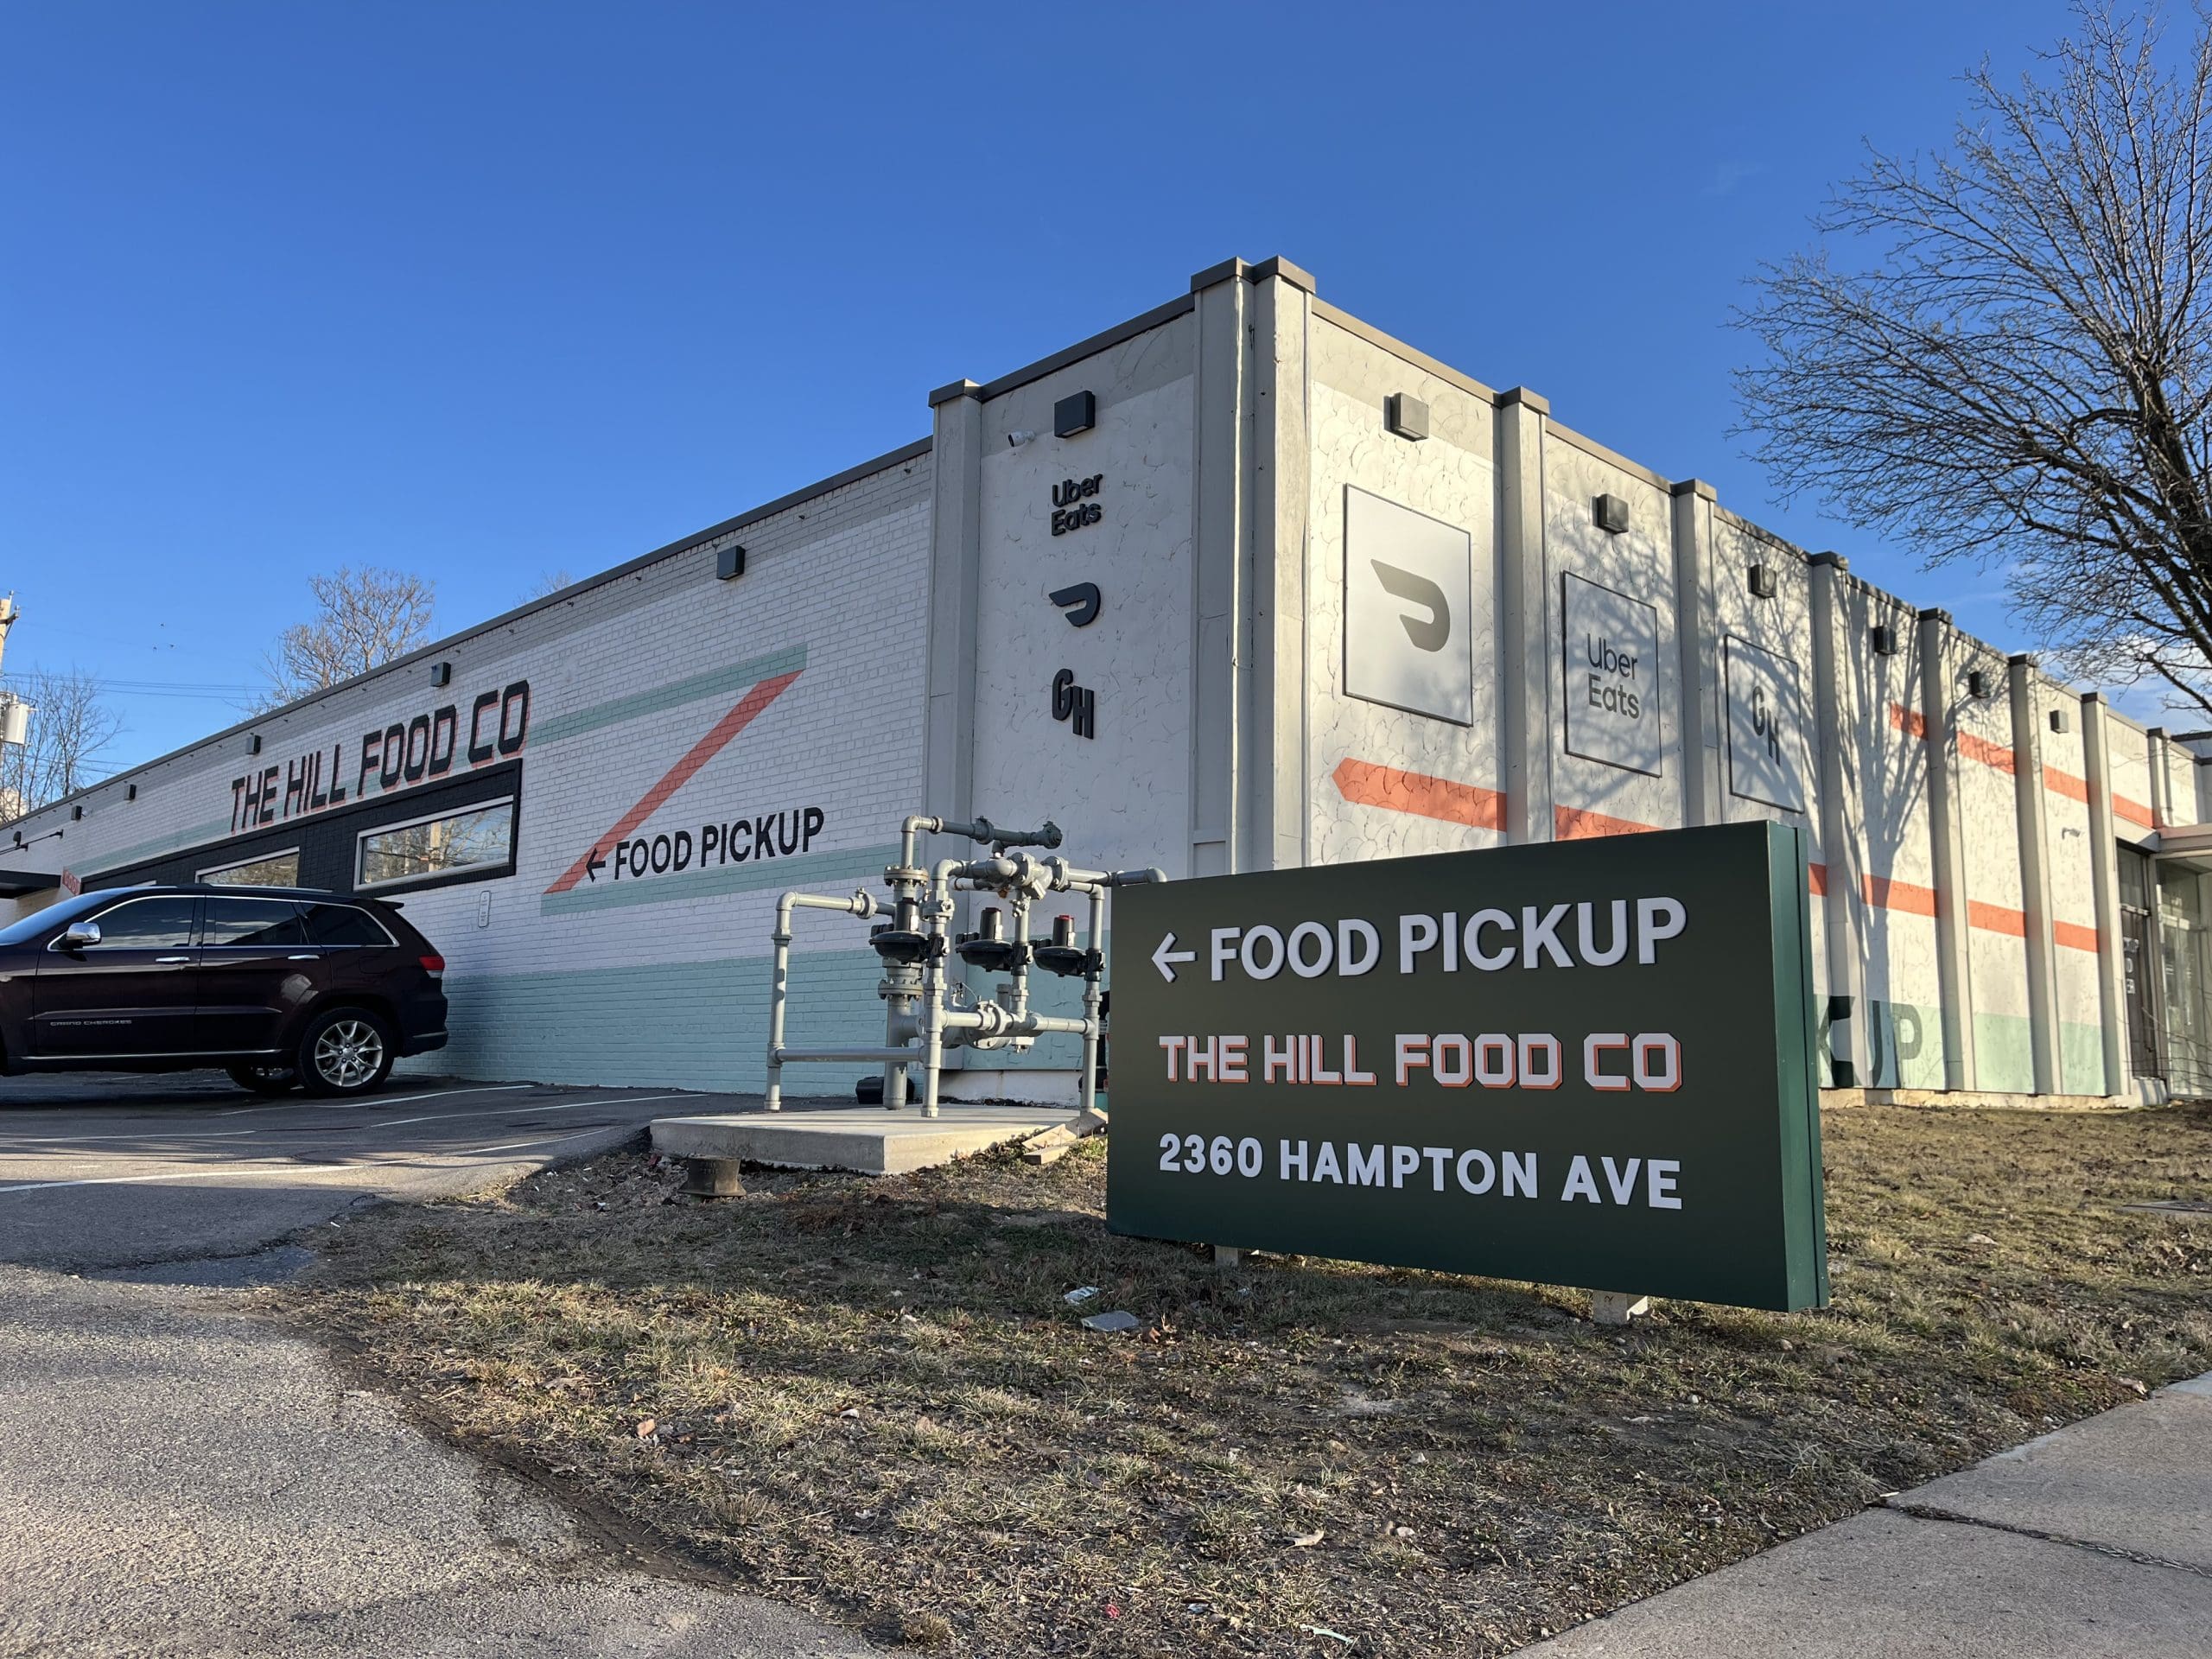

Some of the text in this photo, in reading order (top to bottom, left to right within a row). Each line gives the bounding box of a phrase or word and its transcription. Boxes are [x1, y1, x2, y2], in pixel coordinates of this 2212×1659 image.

[1051, 502, 1102, 537] Eats
[1052, 474, 1103, 508] Uber
[1587, 632, 1638, 681] Uber
[1052, 668, 1095, 740] GH
[1588, 672, 1640, 720] Eats
[1752, 685, 1781, 767] GH
[231, 679, 531, 836] THE HILL FOOD CO
[613, 806, 824, 880] FOOD PICKUP
[1211, 896, 1688, 982] FOOD PICKUP
[1159, 1032, 1683, 1092] THE HILL FOOD CO
[1159, 1132, 1683, 1211] 2360 HAMPTON AVE
